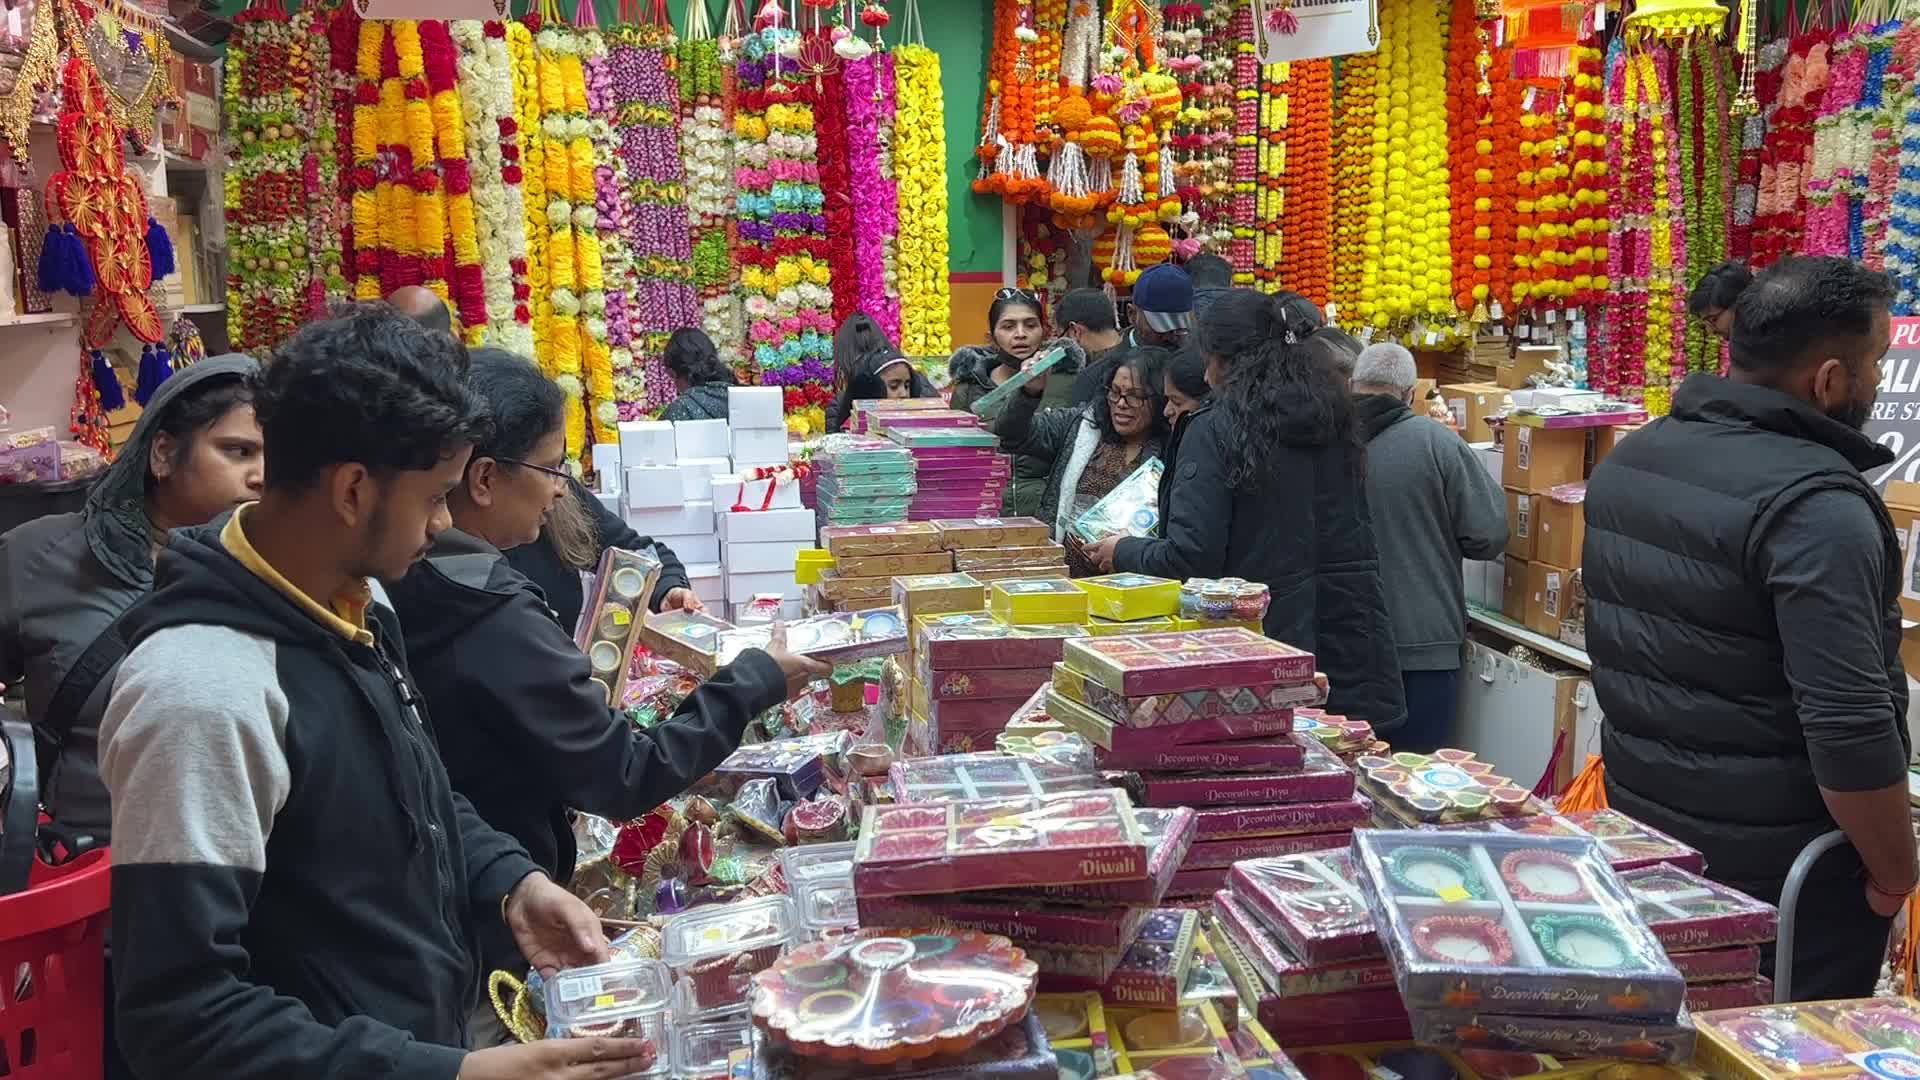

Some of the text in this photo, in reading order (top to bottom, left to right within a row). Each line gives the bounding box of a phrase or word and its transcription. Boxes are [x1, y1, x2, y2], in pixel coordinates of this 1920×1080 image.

[1155, 752, 1240, 766] Decorative Diya
[1204, 786, 1289, 801] Decorative Diya
[1233, 811, 1316, 830] Decorative Diya
[1079, 856, 1136, 877] Diwali
[1111, 985, 1166, 1003] Diwali
[1490, 983, 1600, 1010] Decorative Diya
